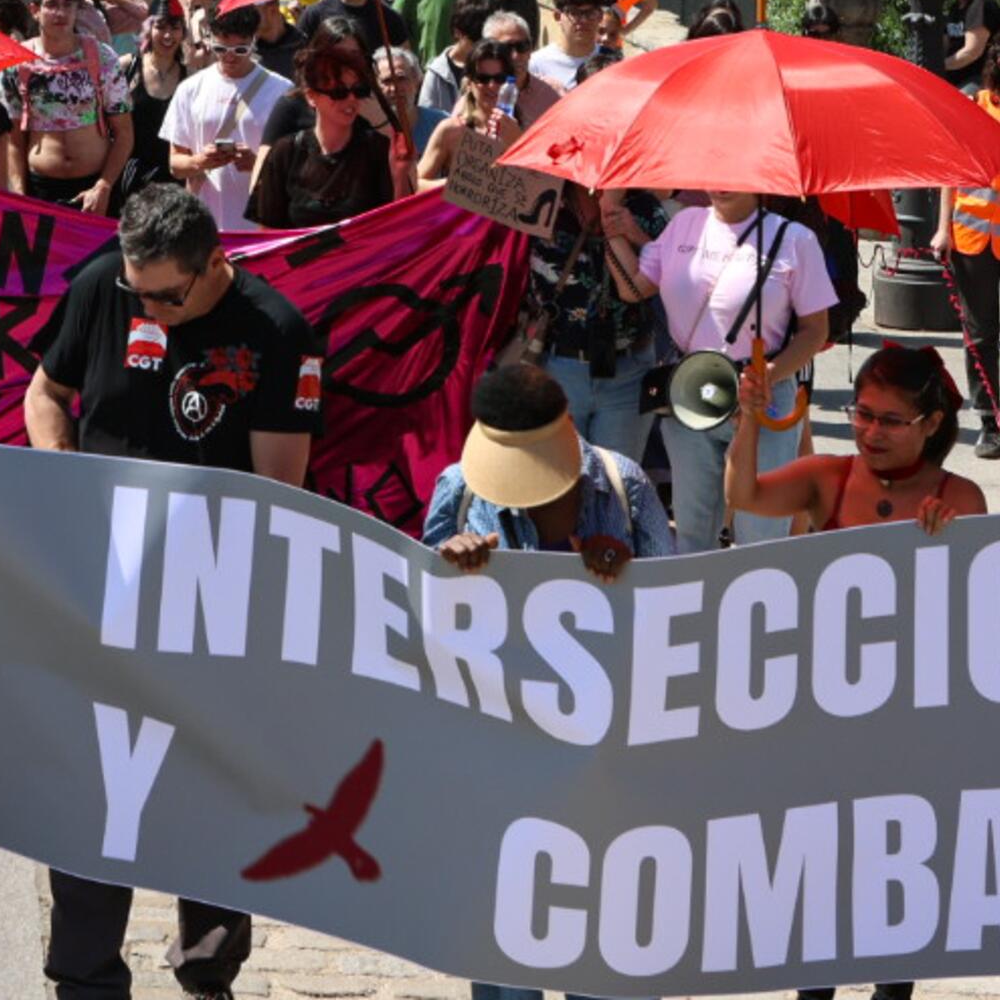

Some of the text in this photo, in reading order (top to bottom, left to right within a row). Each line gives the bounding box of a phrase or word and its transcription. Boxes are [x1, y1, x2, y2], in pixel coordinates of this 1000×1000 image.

[127, 354, 163, 371] CGT
[295, 397, 321, 410] CGT
[93, 702, 176, 861] Y
